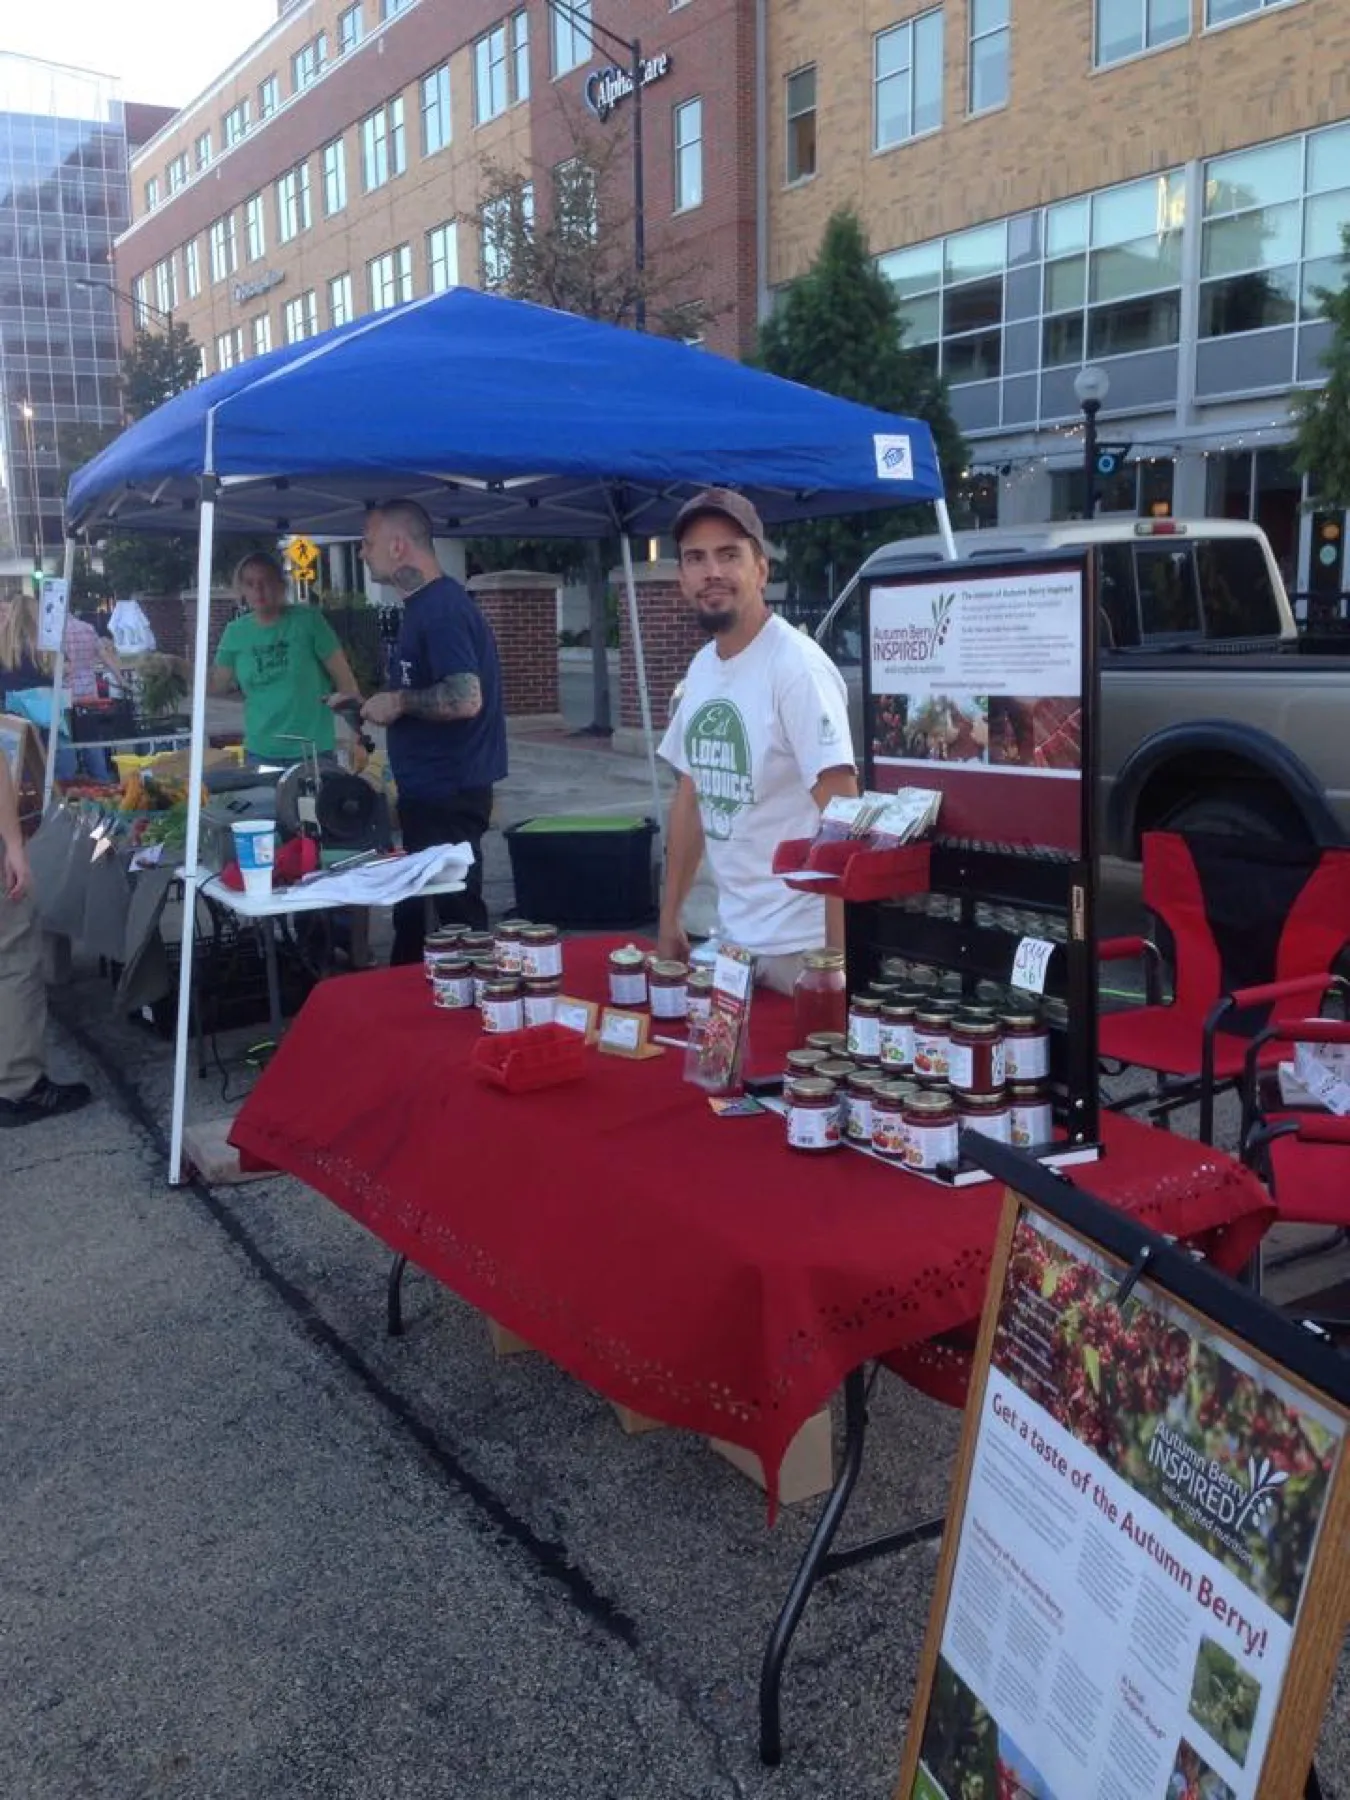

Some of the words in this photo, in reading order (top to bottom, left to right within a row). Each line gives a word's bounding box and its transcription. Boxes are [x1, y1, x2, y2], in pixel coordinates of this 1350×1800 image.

[873, 626, 908, 640] Autumn
[909, 623, 934, 643] Berry
[873, 641, 929, 661] INSPIRED
[691, 737, 737, 771] LOCAL
[1149, 1437, 1235, 1524] INSPIRED
[1154, 1421, 1205, 1474] Autumn
[1208, 1460, 1248, 1506] Berry
[991, 1392, 1018, 1430] Get
[1019, 1420, 1029, 1440] a
[1030, 1428, 1068, 1477] taste
[1071, 1469, 1092, 1495] of
[1093, 1484, 1118, 1524] the
[1120, 1510, 1193, 1592] Autumn
[1197, 1573, 1269, 1658] Berry!
